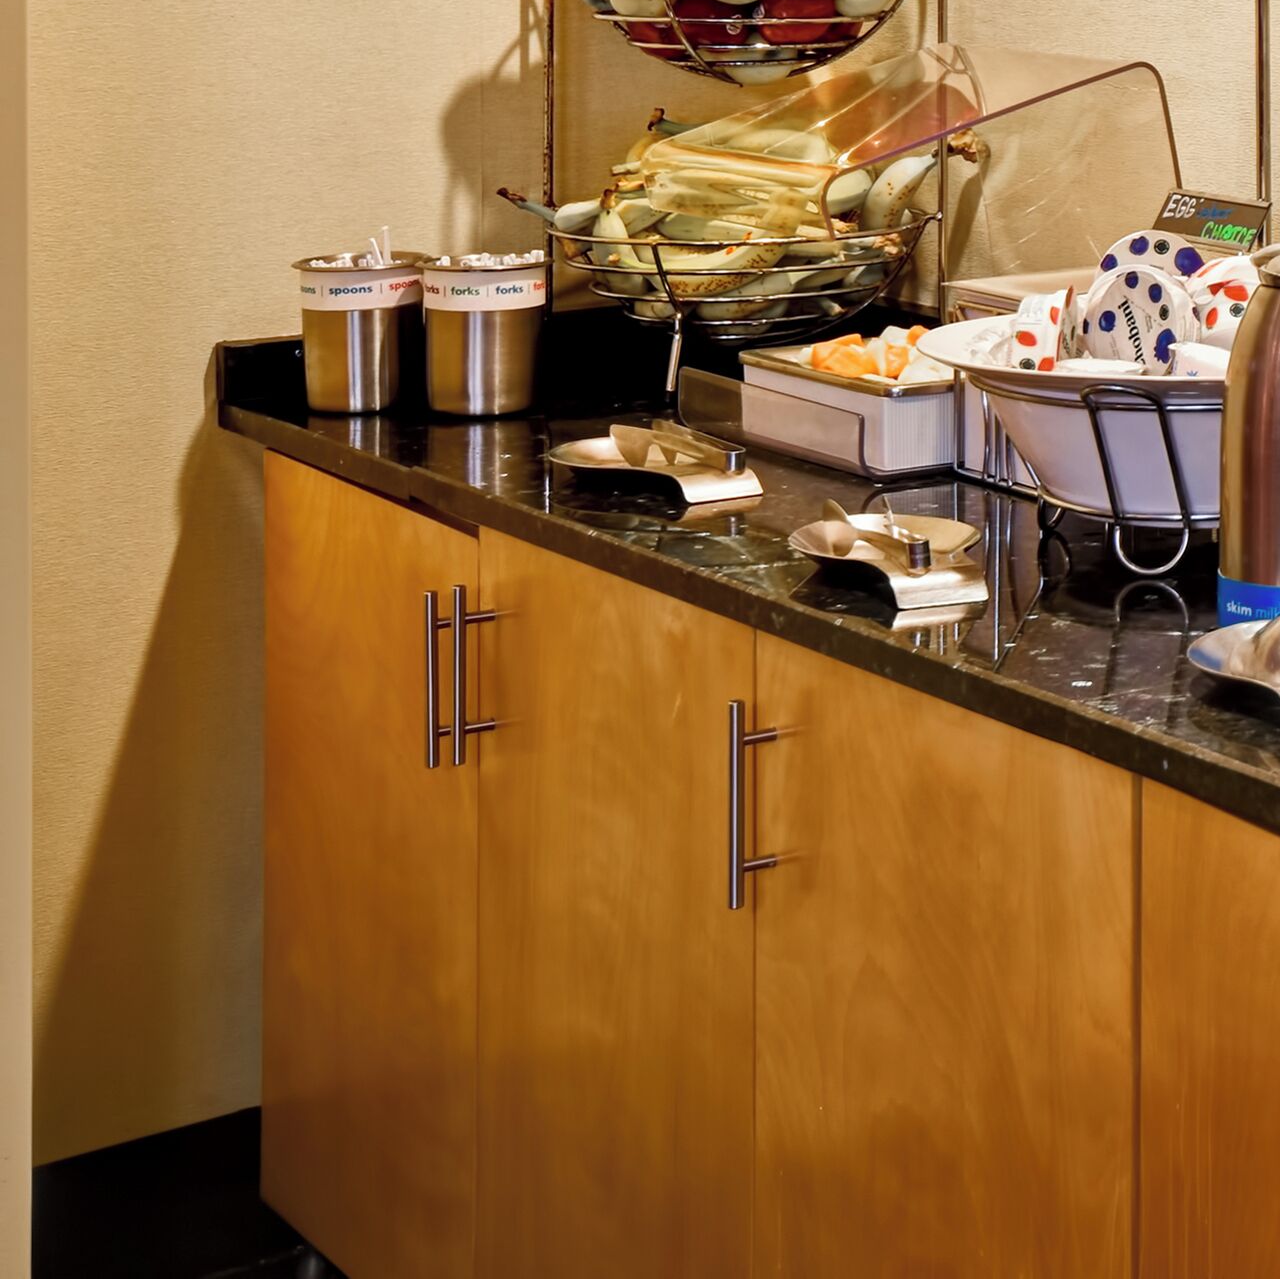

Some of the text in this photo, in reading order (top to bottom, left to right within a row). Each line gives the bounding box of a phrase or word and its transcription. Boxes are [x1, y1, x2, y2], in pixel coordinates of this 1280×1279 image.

[329, 285, 373, 297] spoons
[450, 286, 480, 296] forks
[496, 284, 524, 295] forks
[1226, 600, 1252, 616] skim
